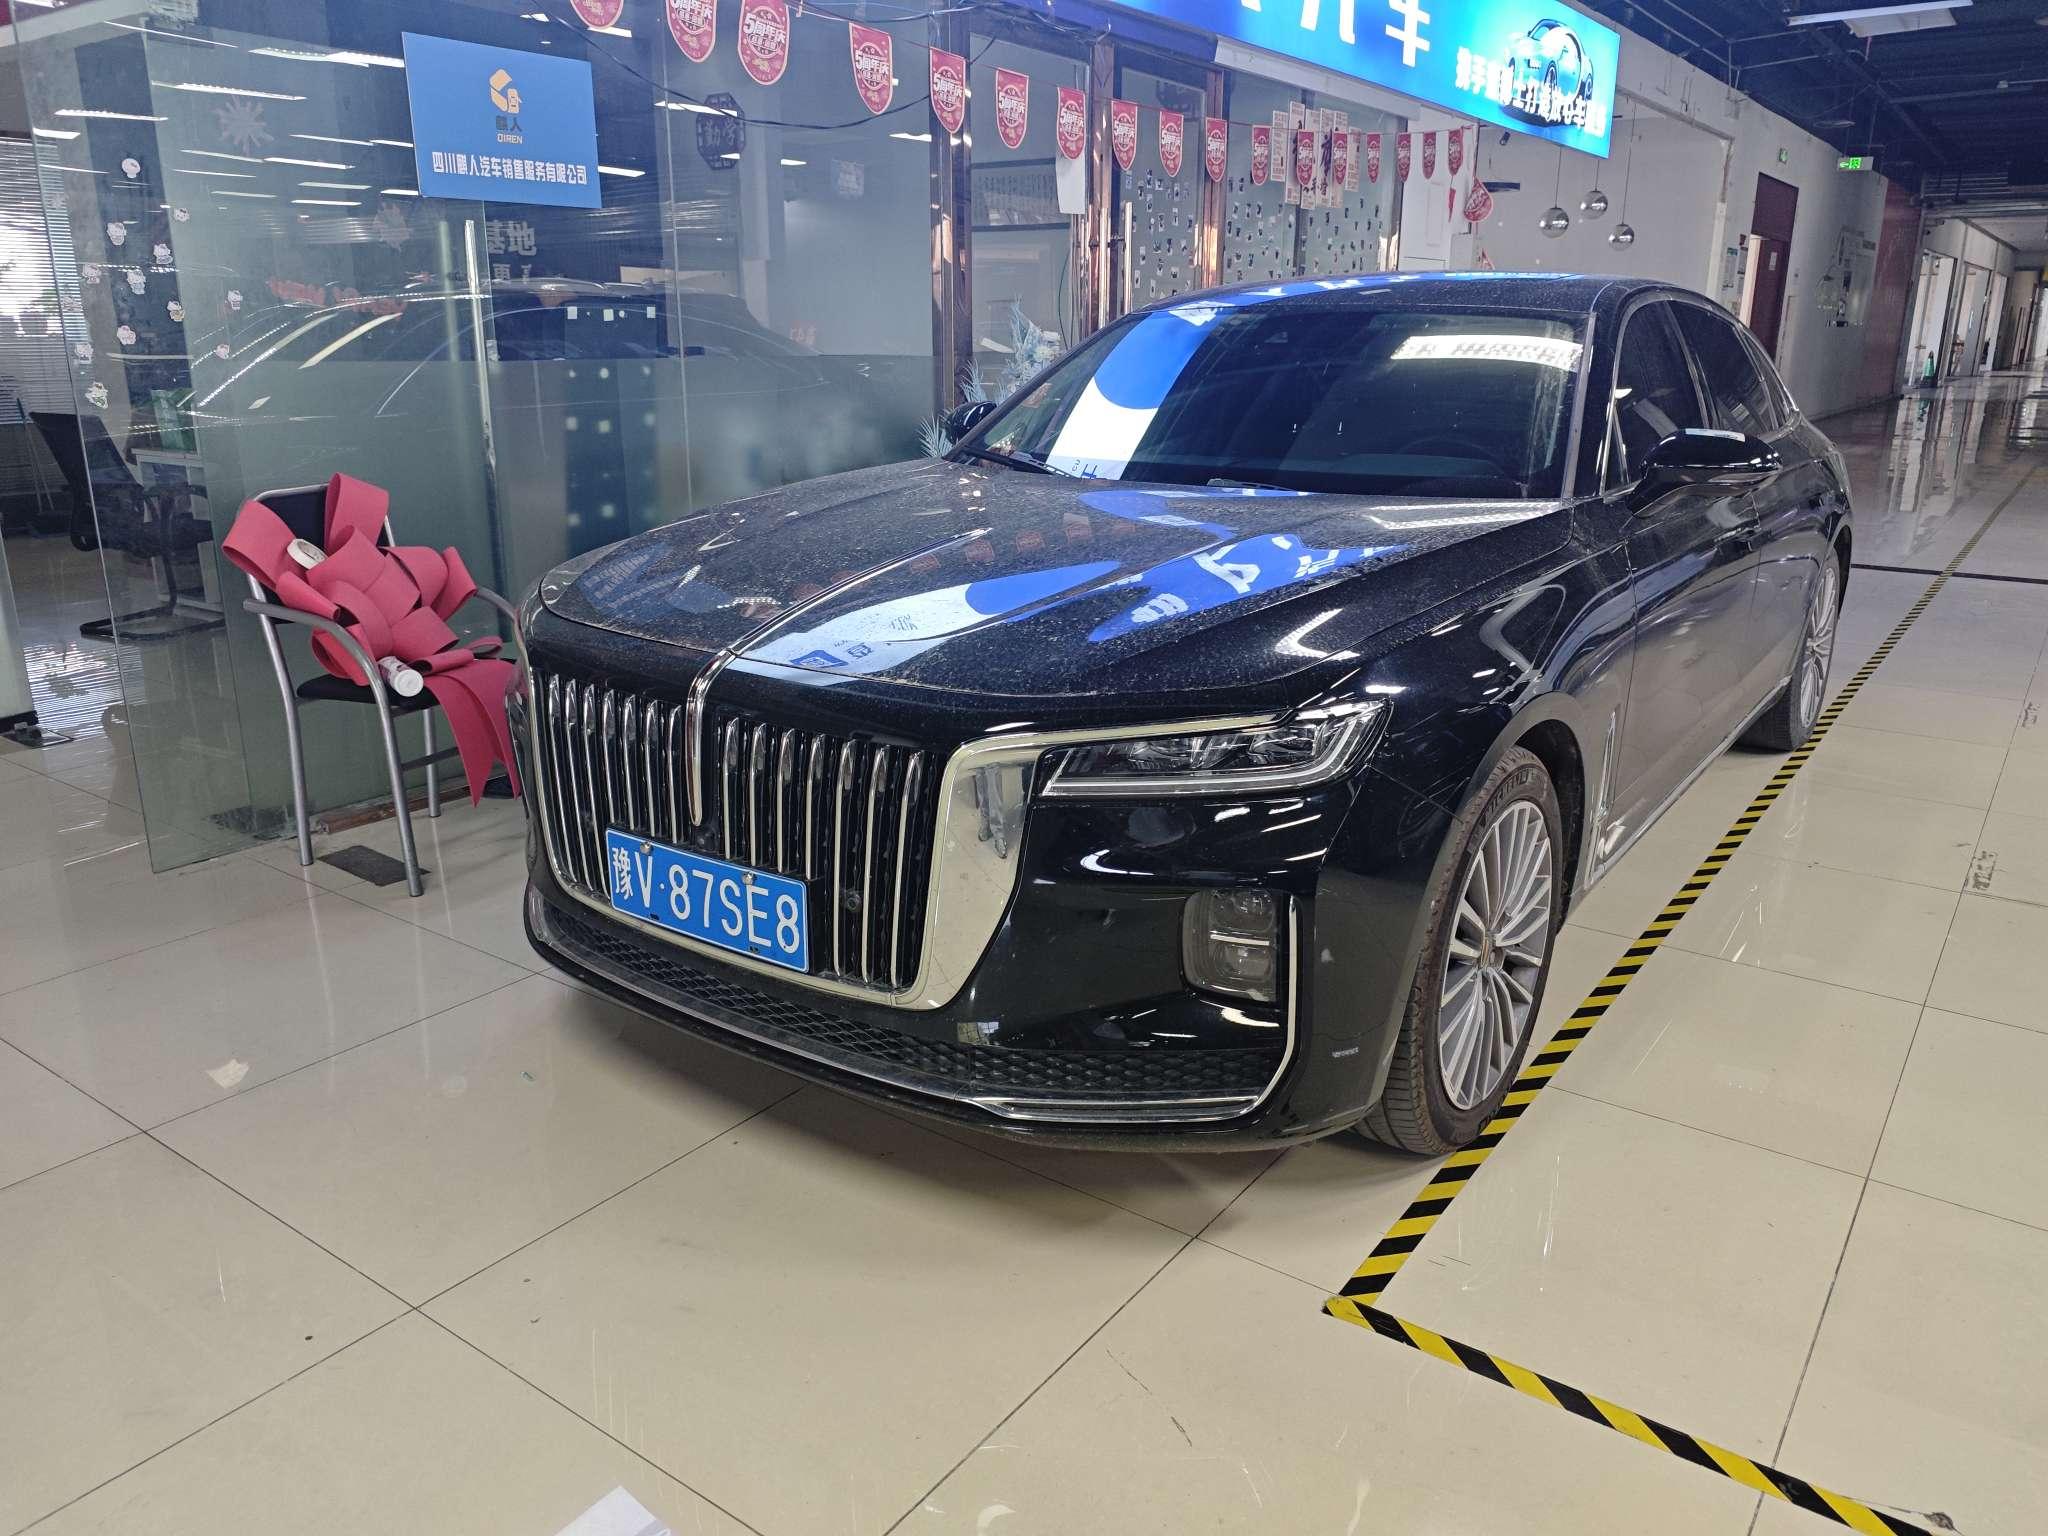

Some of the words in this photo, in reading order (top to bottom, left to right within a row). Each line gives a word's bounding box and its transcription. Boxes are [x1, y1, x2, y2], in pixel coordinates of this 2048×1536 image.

[743, 12, 787, 44] 5周年庆
[855, 49, 890, 75] 5周年庆
[497, 133, 523, 145] QIREN
[611, 846, 800, 954] 豫V·87SE8
